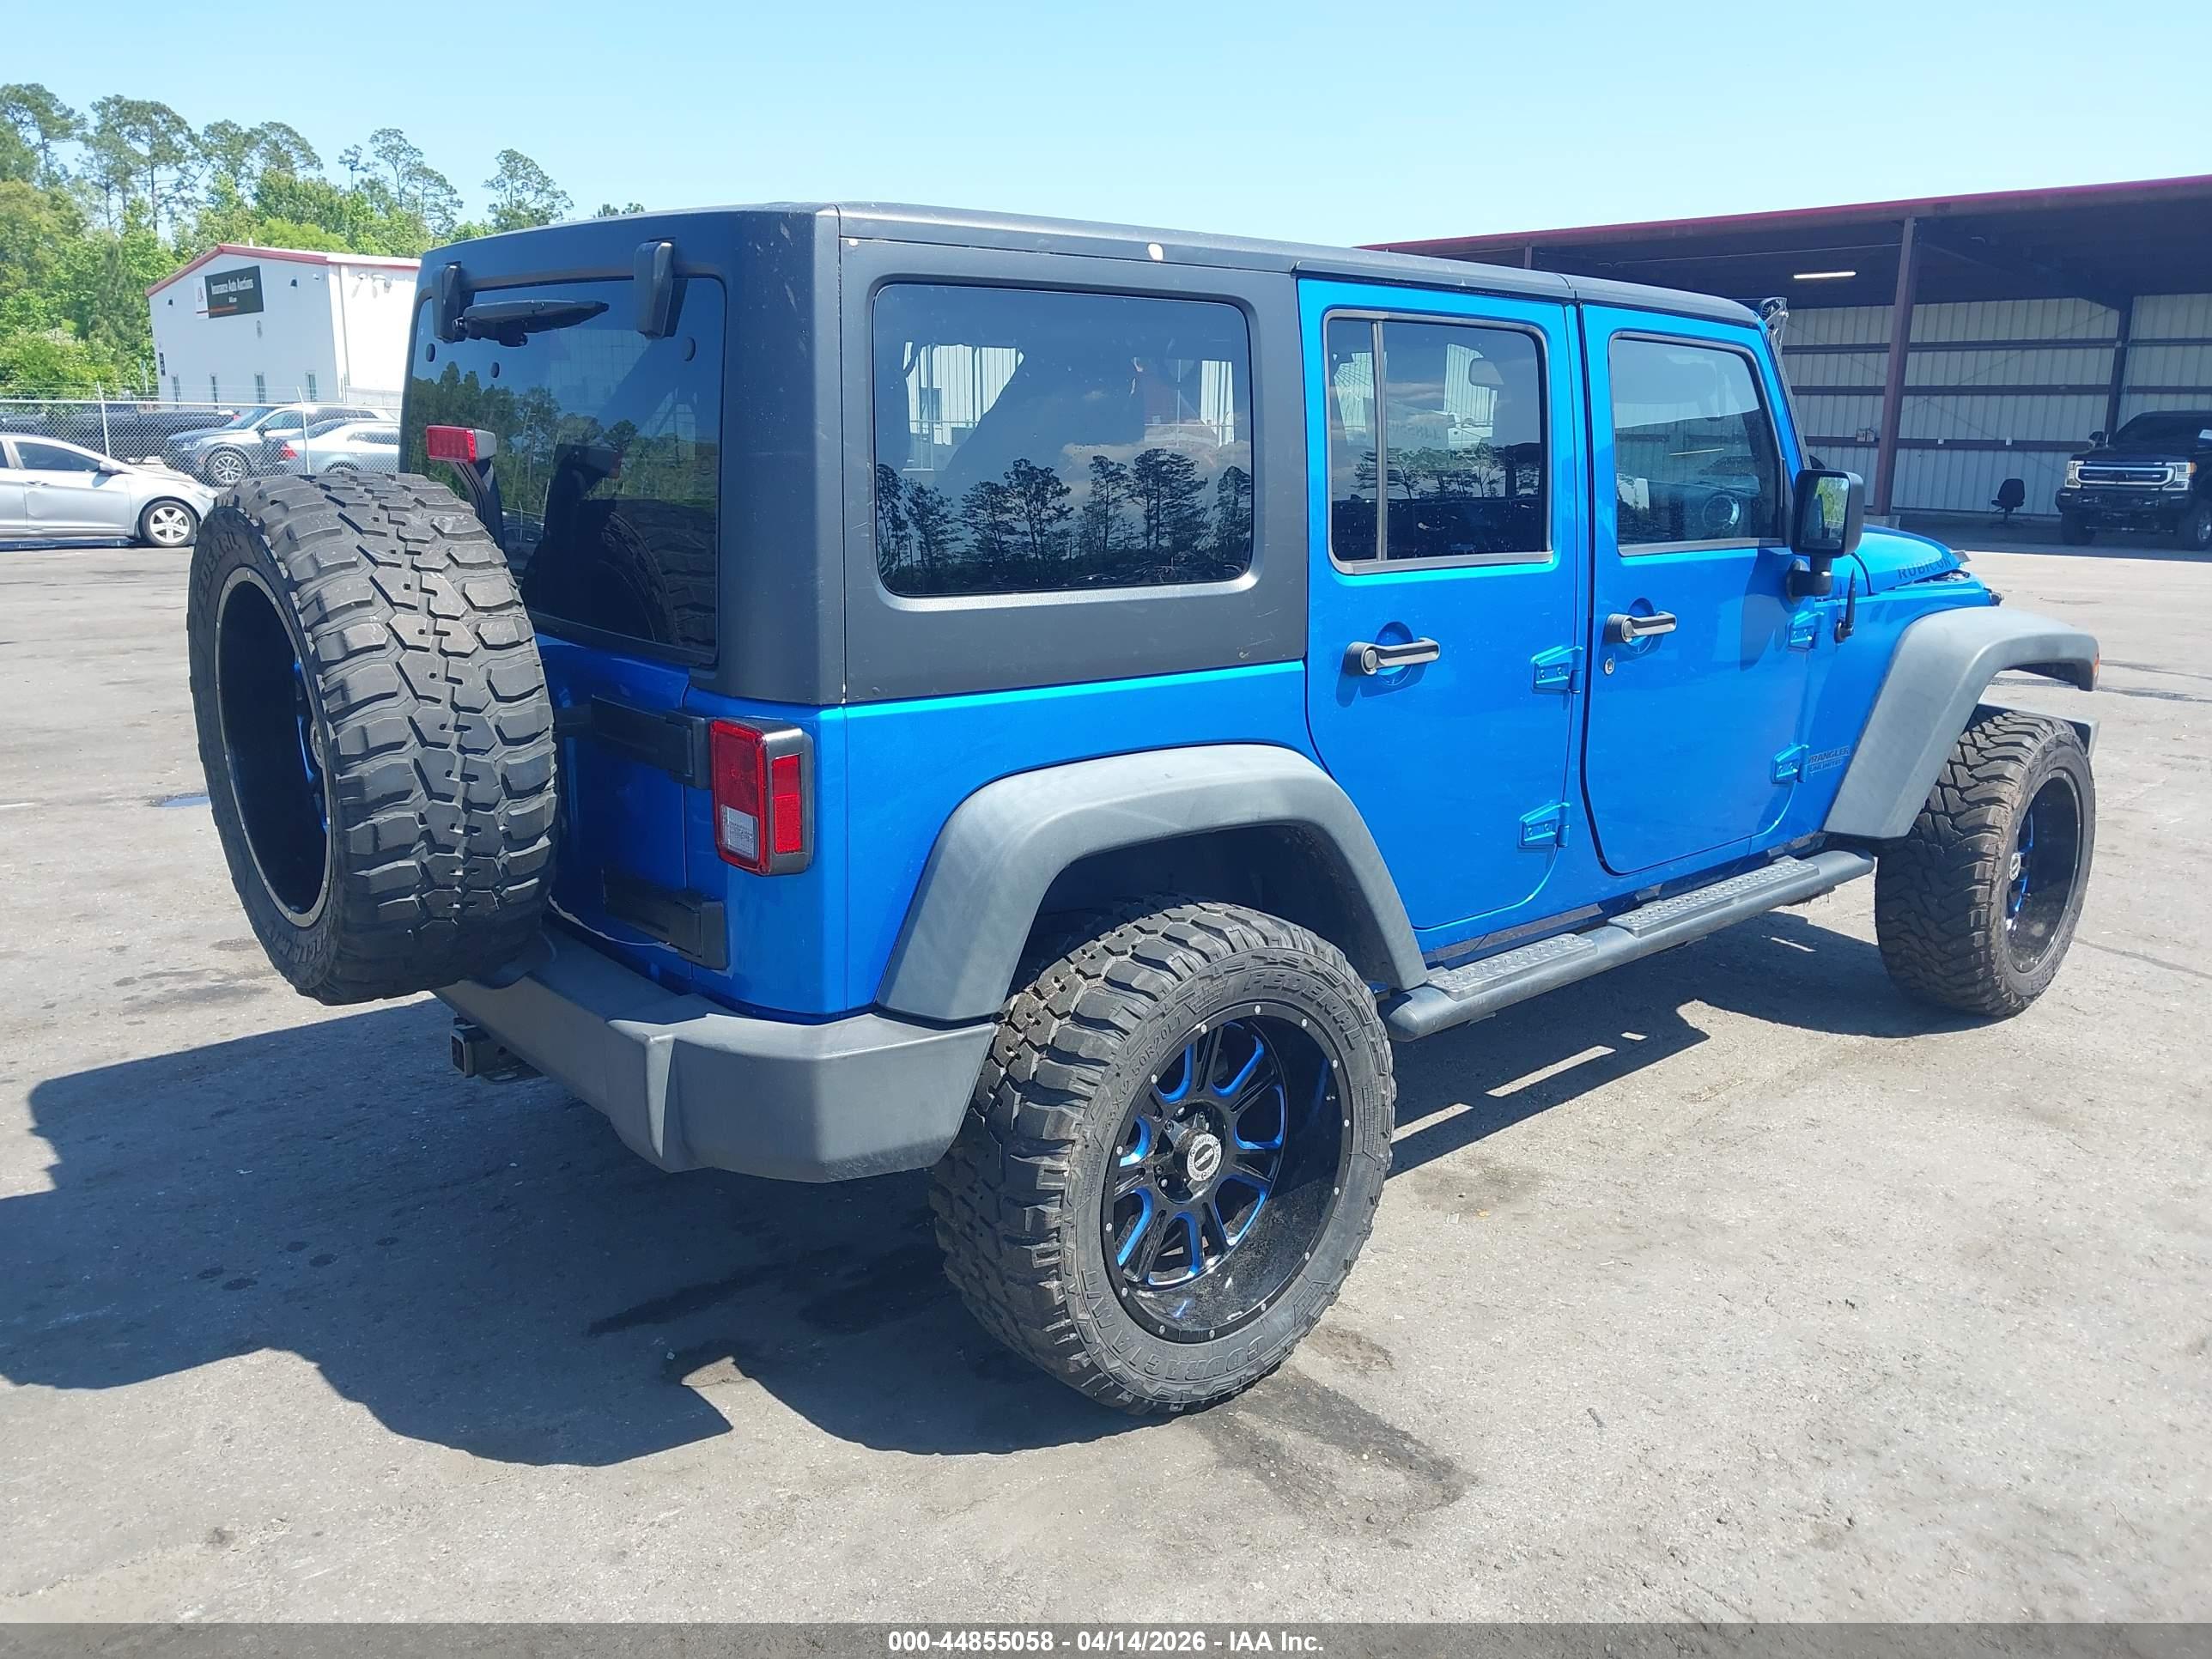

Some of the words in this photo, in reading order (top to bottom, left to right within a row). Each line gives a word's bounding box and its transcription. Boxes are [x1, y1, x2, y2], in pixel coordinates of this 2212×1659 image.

[1897, 556, 1953, 580] RUBICON
[1242, 971, 1362, 1051] FEDERAL
[1111, 1329, 1266, 1381] COURAGIA
